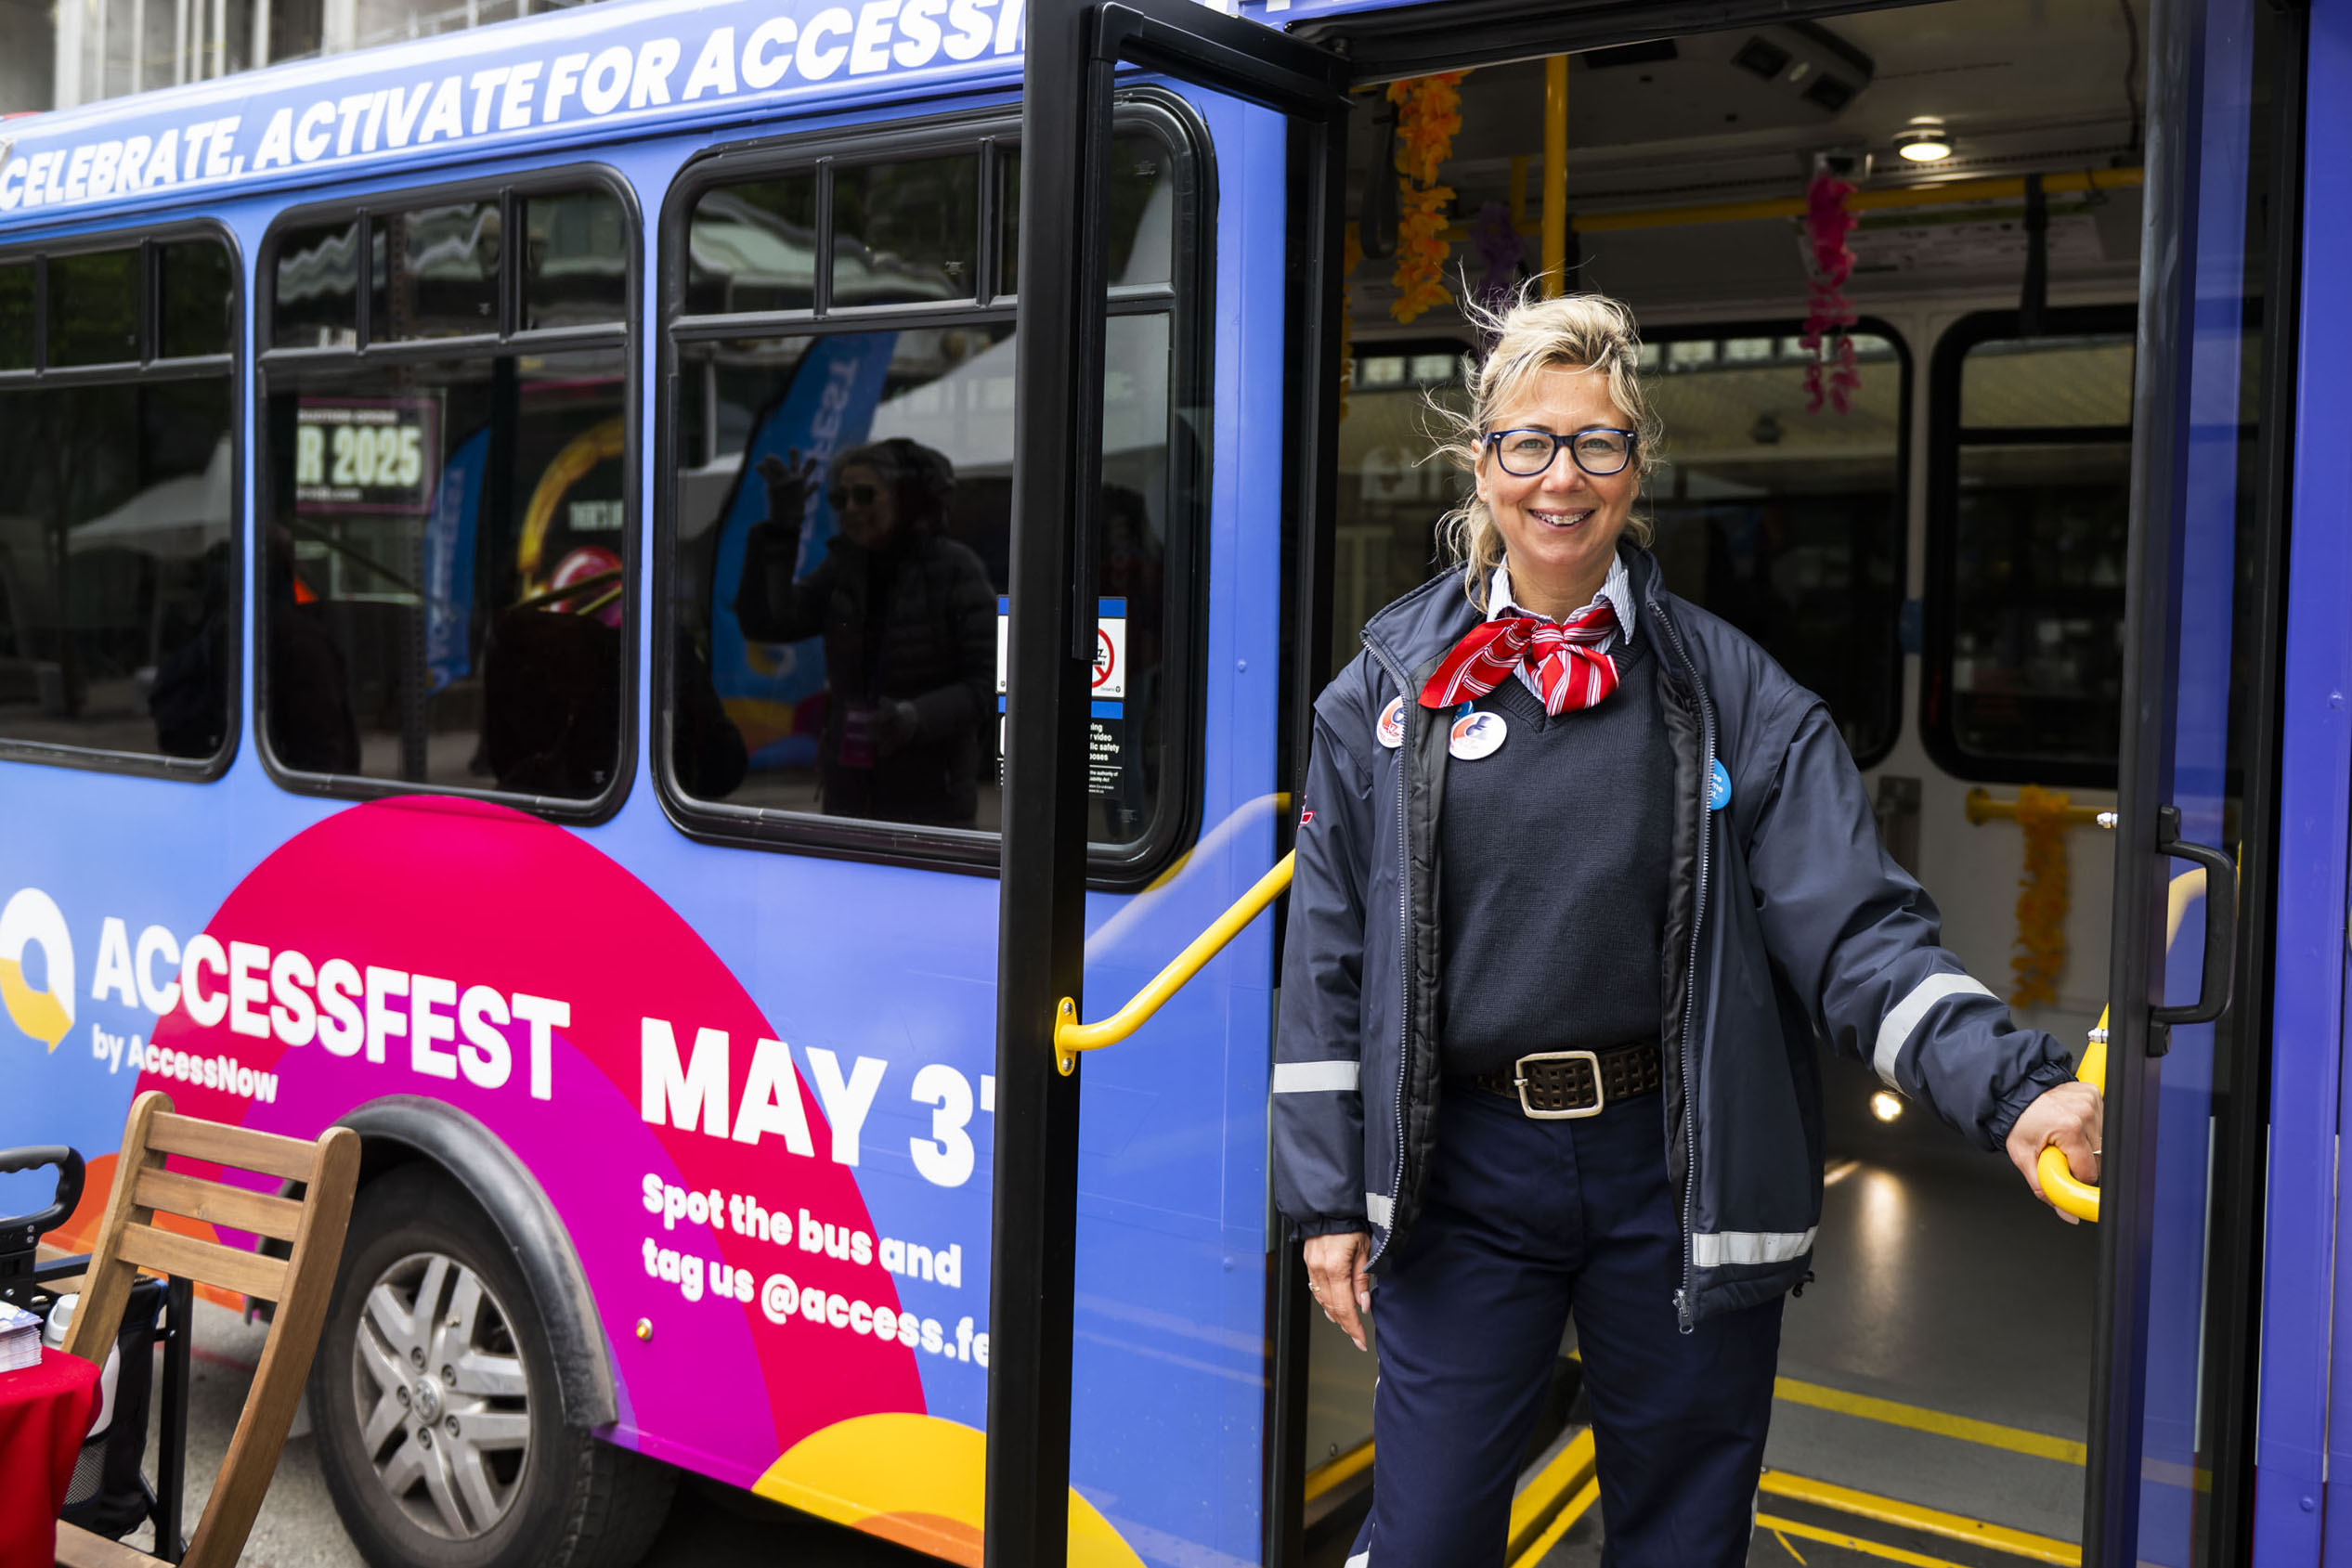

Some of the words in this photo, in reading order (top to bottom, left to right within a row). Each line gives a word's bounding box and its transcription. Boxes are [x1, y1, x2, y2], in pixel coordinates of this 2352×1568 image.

[0, 116, 242, 211] CELEBRATE,
[253, 61, 542, 169] ACTIVATE
[544, 38, 680, 123] FOR
[683, 0, 1024, 100] ACCESSI
[332, 425, 422, 486] 2025
[1093, 732, 1112, 742] video
[1099, 743, 1120, 754] safety
[93, 916, 570, 1100] ACCESSFEST
[93, 1023, 124, 1074] by
[127, 1034, 278, 1103] AccessNow
[642, 1017, 888, 1167] MAY
[910, 1064, 995, 1187] 3
[642, 1173, 724, 1230] Spot
[729, 1194, 793, 1245] the
[799, 1208, 873, 1265] bus
[878, 1237, 962, 1289] and
[642, 1238, 704, 1302] tag
[709, 1262, 755, 1303] us
